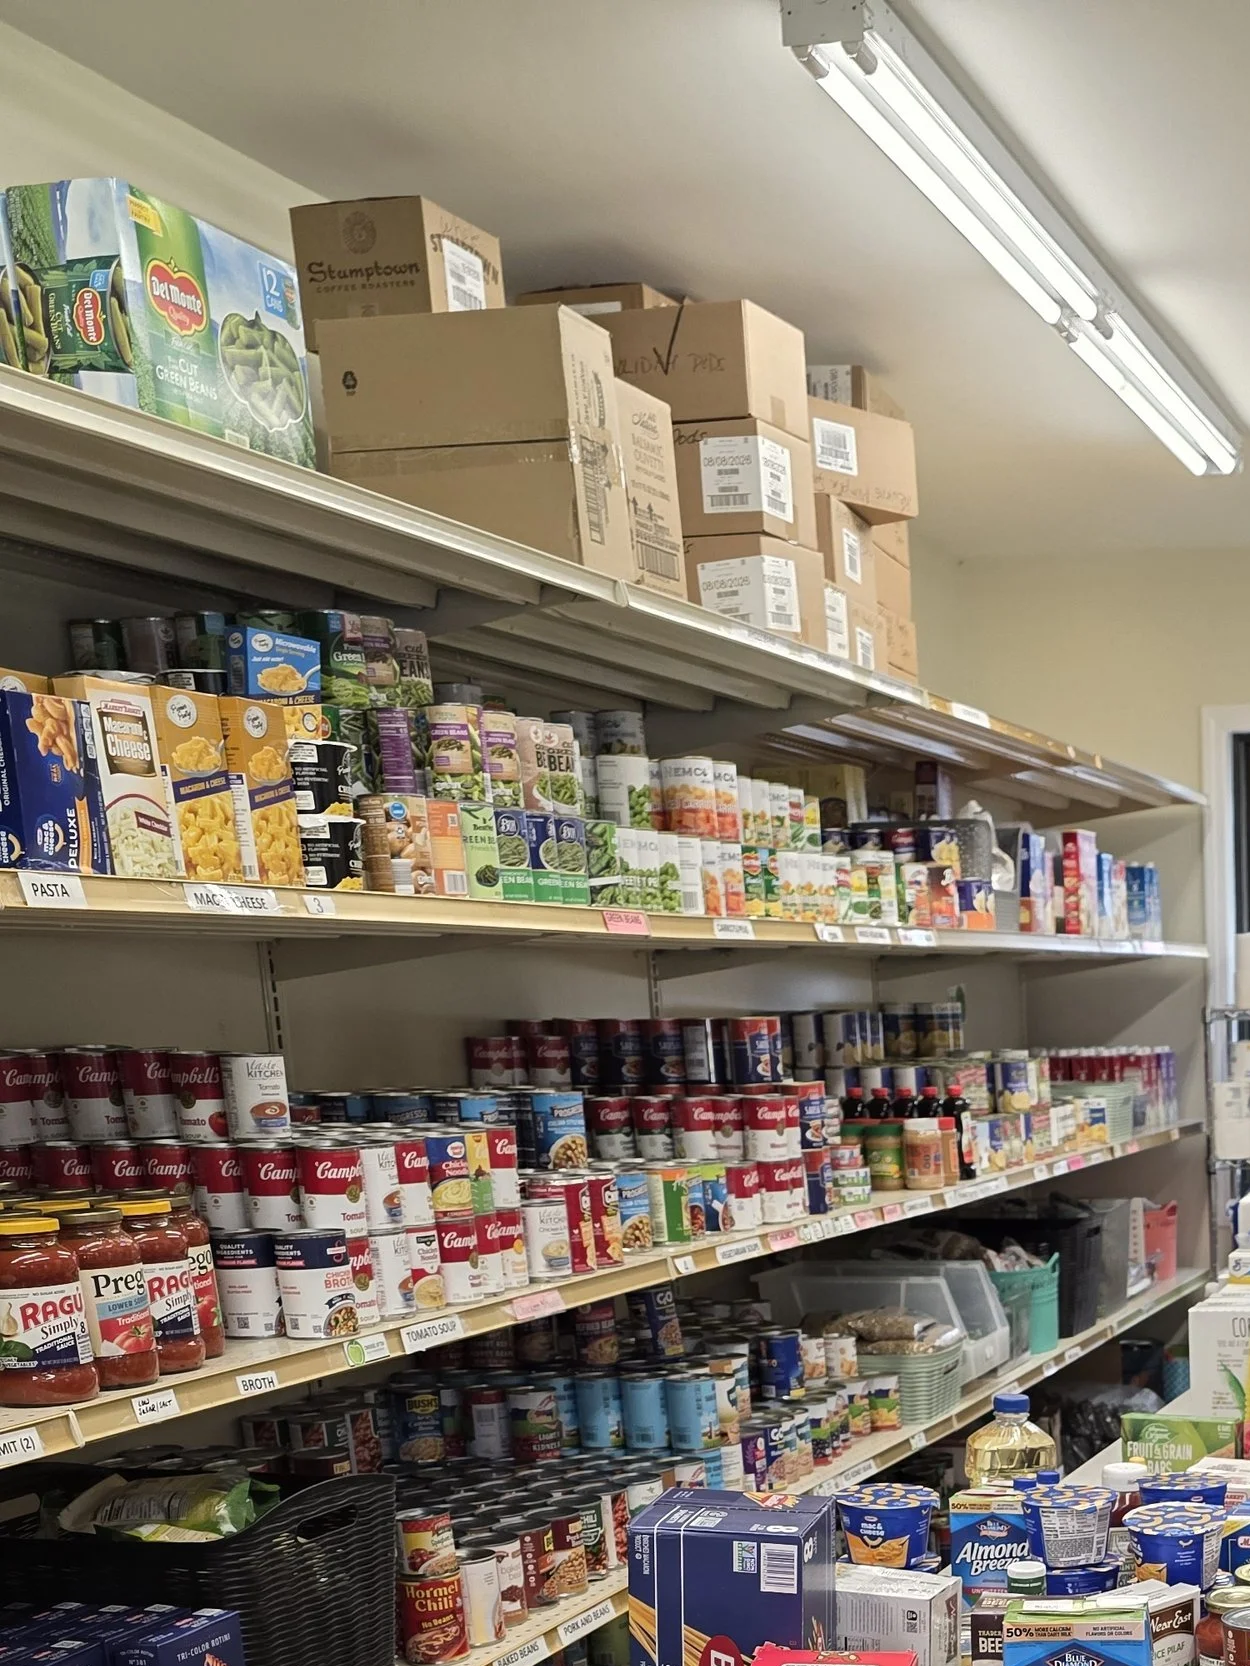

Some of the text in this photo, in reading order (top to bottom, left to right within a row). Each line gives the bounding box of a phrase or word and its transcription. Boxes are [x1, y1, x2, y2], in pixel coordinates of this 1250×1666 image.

[307, 259, 421, 284] Stumptown
[262, 267, 279, 297] 12
[316, 280, 416, 294] COFFEE ROASTERS
[151, 276, 203, 316] Del Monte
[178, 358, 199, 377] CUT
[155, 365, 218, 400] GREEN BEANS
[103, 716, 142, 738] Macaroni
[107, 736, 151, 761] Cheese
[67, 808, 77, 869] DELUXE
[31, 883, 70, 898] PASTA
[194, 892, 221, 906] MAC
[313, 898, 324, 913] 3
[248, 1068, 285, 1079] KITCHEN
[258, 1083, 281, 1091] Tomato
[108, 1298, 129, 1312] LOWER
[40, 1315, 79, 1340] Simply
[405, 1320, 458, 1343] TOMATO SOUP
[35, 1334, 74, 1354] TRADITIONAL
[56, 1340, 76, 1352] SAUCE
[241, 1375, 276, 1393] BROTH
[407, 1395, 440, 1409] BUSH'S
[19, 1435, 36, 1453] (2)
[1127, 1441, 1153, 1458] FRUIT
[1162, 1444, 1193, 1461] GRAIN
[1147, 1459, 1172, 1473] BARS
[955, 1539, 1030, 1564] Almond
[405, 1580, 459, 1600] Hormel
[415, 1595, 453, 1613] Chili
[421, 1613, 454, 1630] No Beans
[563, 1604, 611, 1635] PORK AND BEANS
[1172, 1609, 1192, 1628] East
[1005, 1627, 1035, 1638] 50%
[177, 1632, 232, 1662] TRI-COLOR ROTINI
[519, 1641, 540, 1659] BEANS
[1166, 1641, 1186, 1658] PILAF
[1065, 1653, 1087, 1663] BLUE
